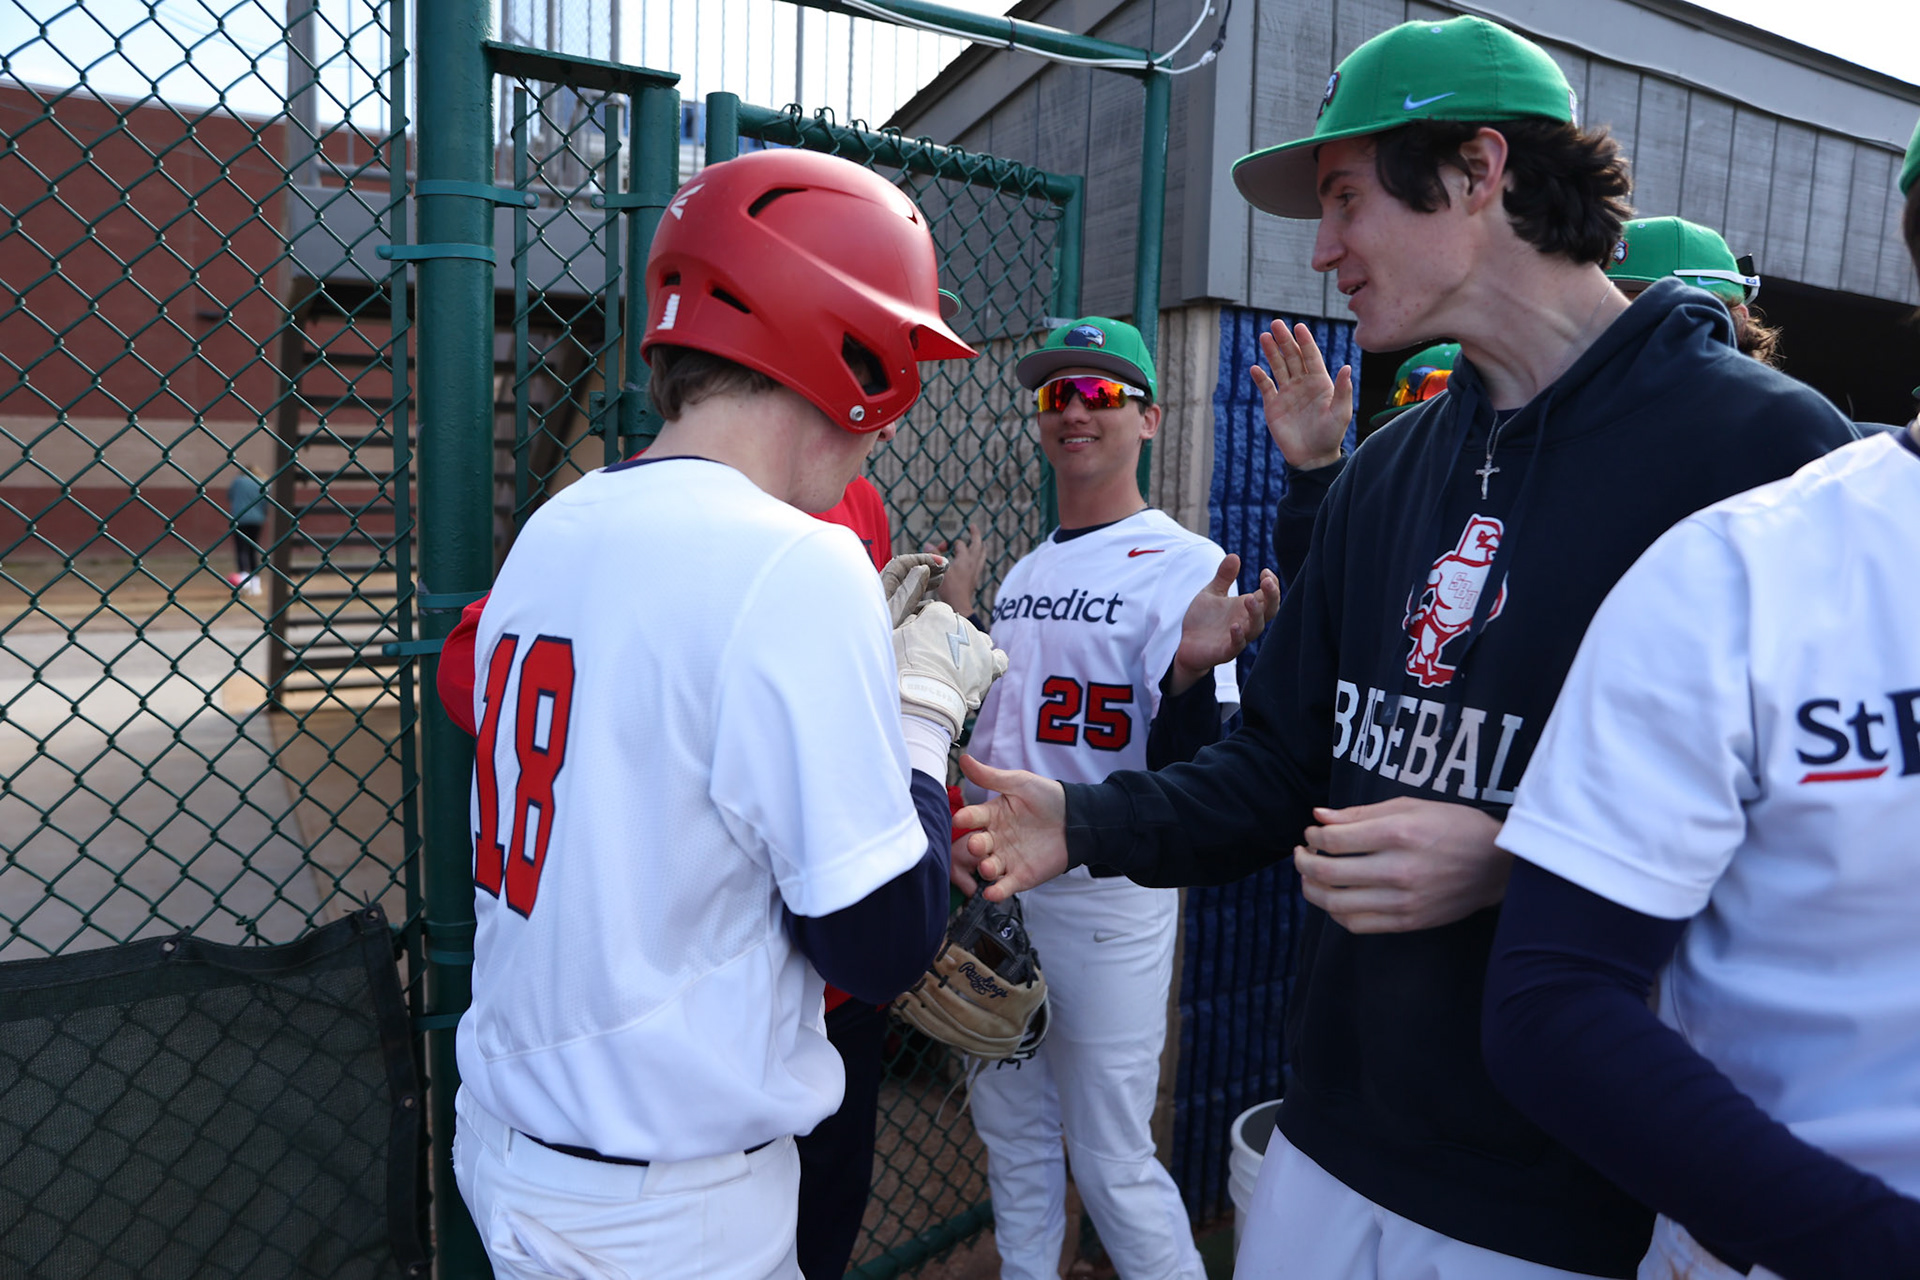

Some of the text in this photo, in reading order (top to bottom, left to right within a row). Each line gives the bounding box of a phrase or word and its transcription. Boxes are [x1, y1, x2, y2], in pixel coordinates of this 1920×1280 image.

[1036, 675, 1133, 752] 25
[474, 632, 575, 920] 18
[958, 961, 1009, 998] Rawlings
